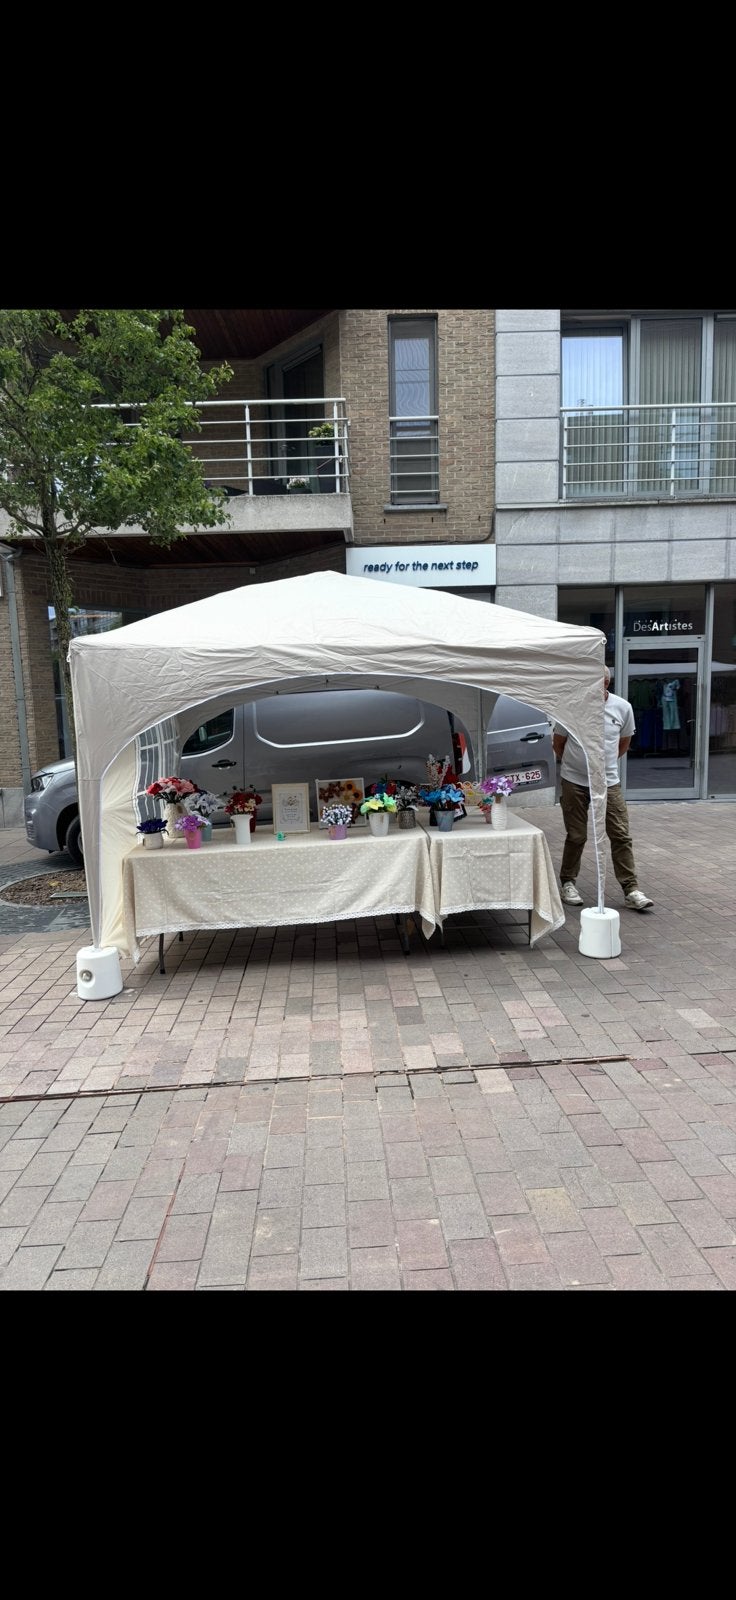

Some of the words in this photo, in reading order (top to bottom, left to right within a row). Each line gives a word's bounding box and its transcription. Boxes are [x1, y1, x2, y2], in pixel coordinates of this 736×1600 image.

[363, 562, 392, 574] ready
[395, 561, 410, 572] for
[412, 560, 428, 571] the
[430, 560, 454, 571] next
[456, 560, 479, 571] step
[633, 621, 693, 632] DesArtistes
